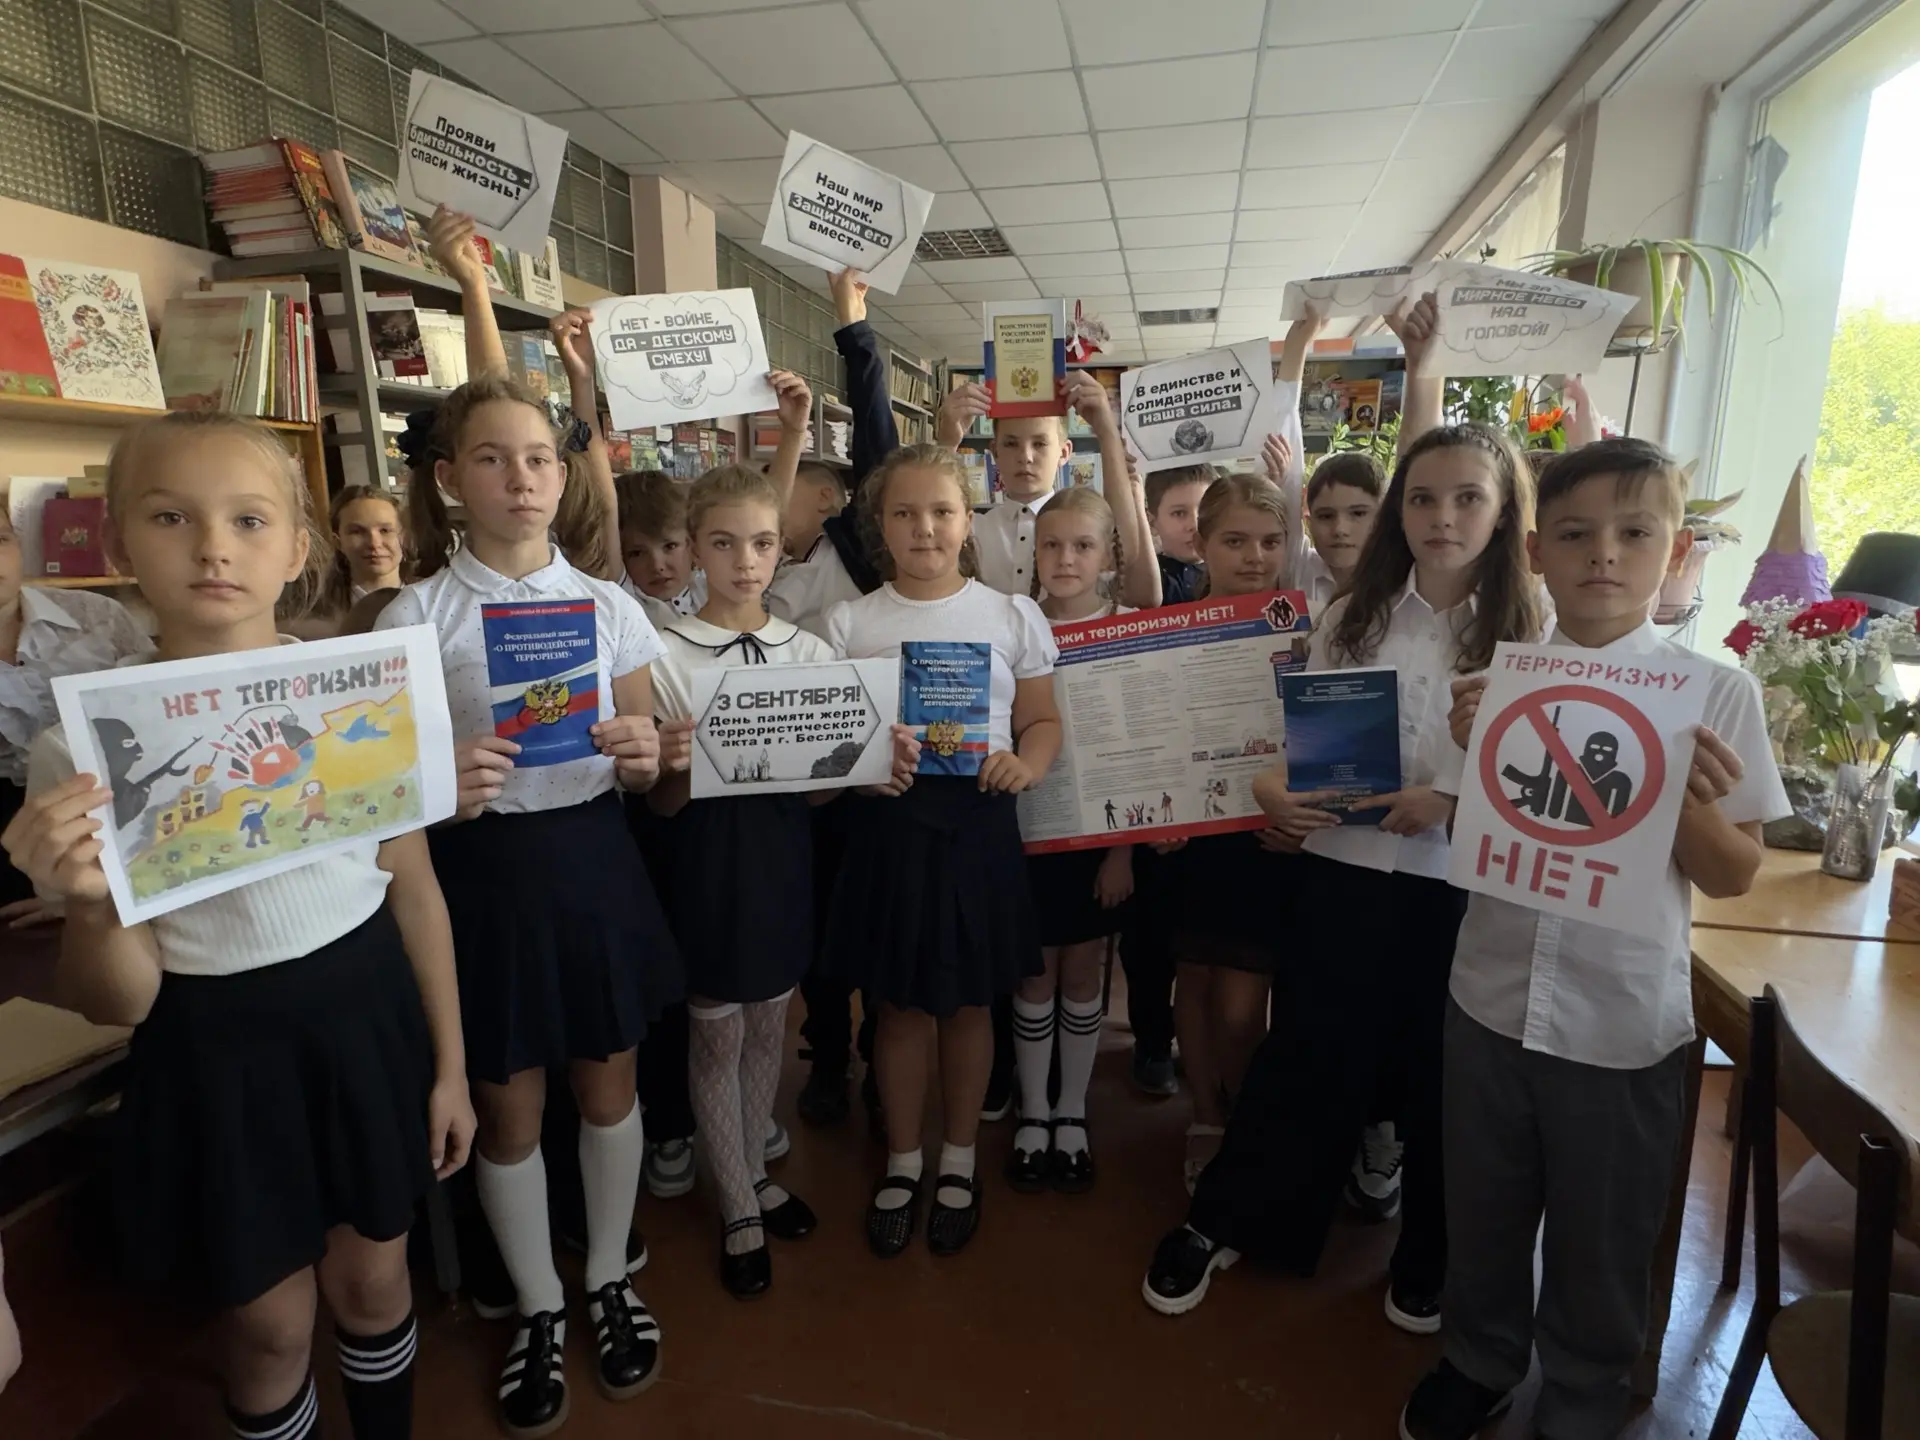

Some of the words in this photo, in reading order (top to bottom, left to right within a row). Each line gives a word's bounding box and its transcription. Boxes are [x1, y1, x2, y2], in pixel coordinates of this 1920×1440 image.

[435, 116, 497, 153] Прояви
[409, 127, 518, 181] бдительность
[411, 147, 449, 171] спаси
[451, 163, 521, 201] жизнь!
[815, 172, 849, 197] Наш
[852, 191, 883, 217] мир
[816, 190, 873, 224] хрупок.
[792, 194, 861, 235] Защитим
[863, 228, 890, 247] его
[808, 220, 865, 252] вместе.
[1495, 278, 1525, 289] МЫ
[1527, 283, 1552, 292] ЗА
[1455, 289, 1528, 302] МИРНОЕ
[1531, 293, 1581, 308] НЕБО
[620, 317, 649, 331] НЕТ
[663, 310, 719, 328] ВОЙНЕ,
[1490, 306, 1527, 319] НАД
[999, 322, 1048, 330] КОНСТИТУЦИЯ
[1465, 323, 1550, 341] ГОЛОВОЙ!
[614, 336, 637, 351] ДА
[651, 328, 734, 349] ДЕТСКОМУ
[1003, 337, 1044, 345] ФЕДЕРАЦИИ
[651, 350, 707, 367] СМЕХУ!
[1136, 386, 1146, 398] В
[1150, 370, 1225, 396] единстве
[1230, 368, 1241, 379] и
[1128, 382, 1242, 413] солидарности
[1142, 407, 1186, 425] наша
[1190, 399, 1237, 415] сила.
[504, 630, 556, 641] Федеральный
[558, 629, 579, 637] закон
[1054, 631, 1085, 646] ажи
[1088, 613, 1191, 640] терроризму
[1196, 605, 1236, 622] НЕТ!
[504, 638, 590, 652] ПРОТИВОДЕЙСТВИИ
[919, 658, 985, 667] ПРОТИВОДЕЙСТВИИ
[1505, 653, 1690, 691] ТЕРРОРИЗМУ
[717, 694, 731, 711] 3
[736, 685, 861, 709] СЕНТЯБРЯ!
[919, 686, 984, 694] ПРОТИВОДЕЙСТВИИ
[161, 687, 222, 721] НЕТ
[709, 716, 751, 728] День
[757, 712, 815, 724] памяти
[820, 708, 866, 720] жертв
[709, 719, 866, 739] террористического
[721, 738, 758, 748] акта
[763, 737, 772, 746] в
[778, 736, 790, 745] г.
[795, 732, 854, 744] Беслан
[1476, 834, 1619, 908] НЕТ
